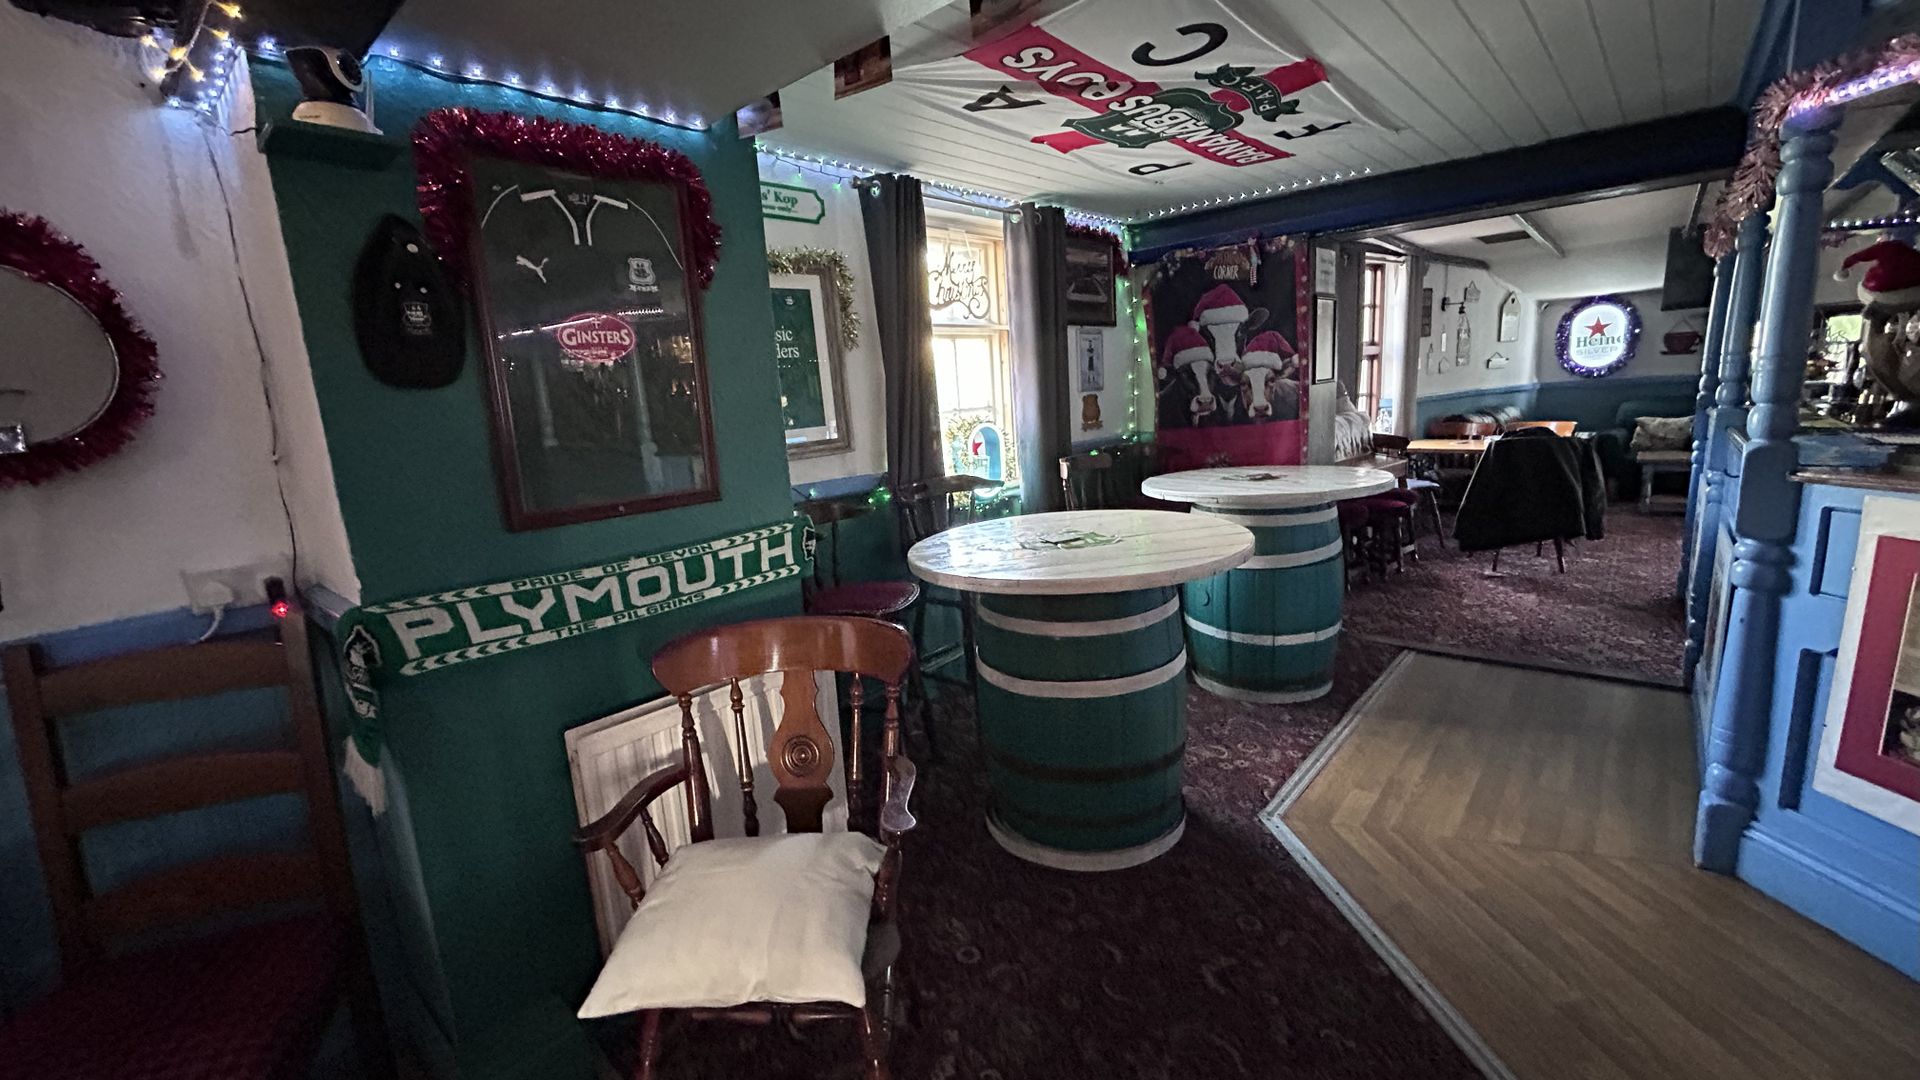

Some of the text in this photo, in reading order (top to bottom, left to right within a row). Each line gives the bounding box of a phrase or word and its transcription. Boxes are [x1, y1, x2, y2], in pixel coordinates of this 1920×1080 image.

[774, 190, 798, 208] Kop
[1213, 264, 1239, 280] CORNER
[561, 327, 631, 346] GINSTERS
[511, 542, 713, 589] PRIDE OF DEVON
[385, 531, 796, 660] PLYMOUTH
[550, 592, 705, 639] THE PILGRIMS
